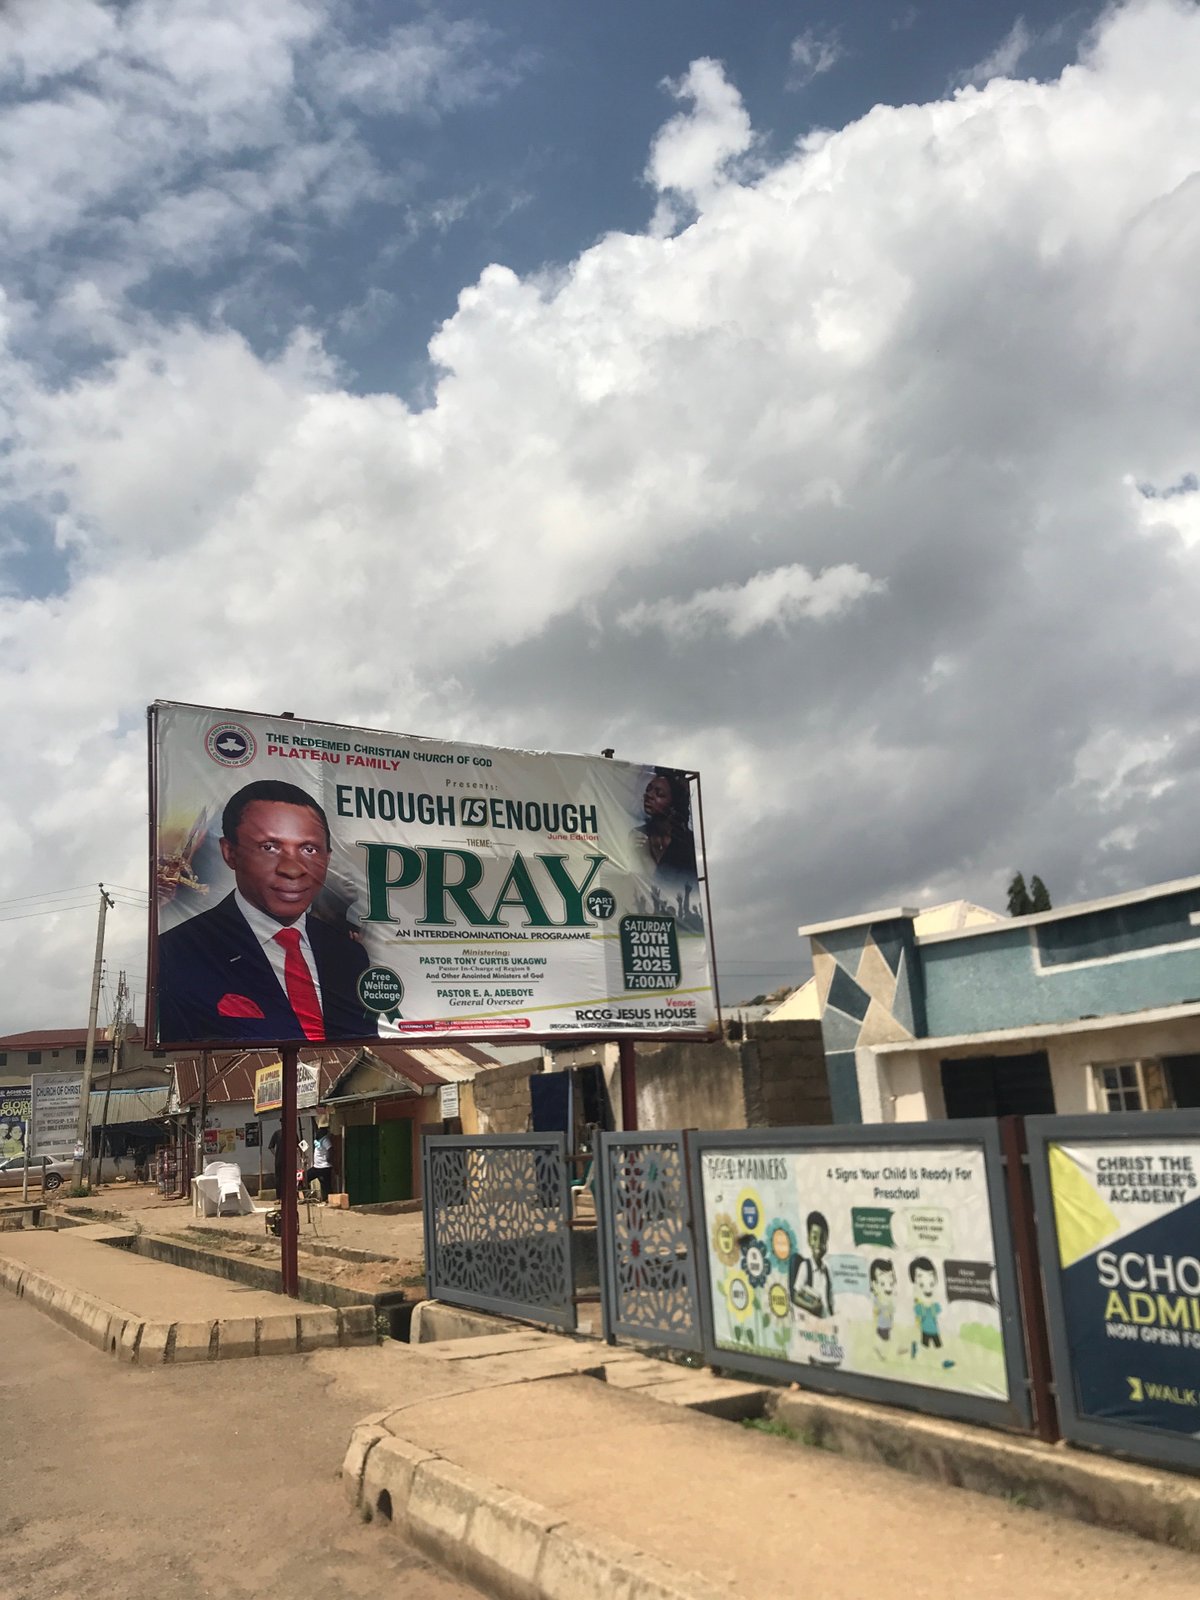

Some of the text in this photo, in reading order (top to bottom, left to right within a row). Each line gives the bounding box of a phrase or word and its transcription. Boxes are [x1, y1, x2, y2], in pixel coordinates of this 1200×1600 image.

[266, 732, 493, 768] THE REDEEMED CHRISTIAN CHURCH OF GOD
[267, 744, 400, 771] PLATEAU FAMILY
[445, 778, 499, 791] Presents:
[336, 784, 598, 833] ENOUGH IS ENOUGH
[466, 838, 493, 848] THEME:
[547, 833, 600, 841] June Edition
[357, 841, 609, 928] PRAY
[588, 897, 613, 905] PART
[591, 904, 612, 917] 17
[625, 920, 672, 932] SATURDAY
[395, 929, 591, 940] AN INTERDENOMINATIONAL PROGRAMME
[630, 932, 669, 945] 20TH
[462, 949, 511, 957] Ministering:
[631, 946, 671, 958] JUNE
[419, 957, 452, 965] PASTOR
[454, 957, 477, 965] TONY
[479, 957, 509, 965] CURTIS
[633, 960, 672, 972] 2025
[371, 971, 391, 981] Free
[626, 975, 677, 988] 7:00AM
[364, 980, 398, 990] Welfare
[363, 990, 401, 1001] Package
[437, 989, 471, 997] PASTOR
[474, 989, 482, 997] E.
[484, 989, 492, 997] A.
[448, 998, 525, 1006] General Overseer
[666, 998, 696, 1007] Venue:
[576, 1008, 697, 1021] RCCG JESUS HOUSE
[36, 1085, 81, 1097] CHURCH OF CHRIST
[2, 1100, 31, 1110] GLORY
[0, 1108, 32, 1117] POWER
[1096, 1156, 1193, 1171] CHRIST THE
[826, 1168, 833, 1178] 4
[835, 1168, 858, 1182] Signs
[860, 1168, 880, 1180] Your
[882, 1168, 907, 1180] Child
[921, 1168, 951, 1183] Ready
[955, 1168, 972, 1180] For
[873, 1187, 920, 1200] Preschool
[1110, 1188, 1187, 1206] ACADEMY
[1096, 1250, 1200, 1297] SCHO
[1104, 1289, 1200, 1332] ADMI
[1141, 1326, 1181, 1347] OPEN
